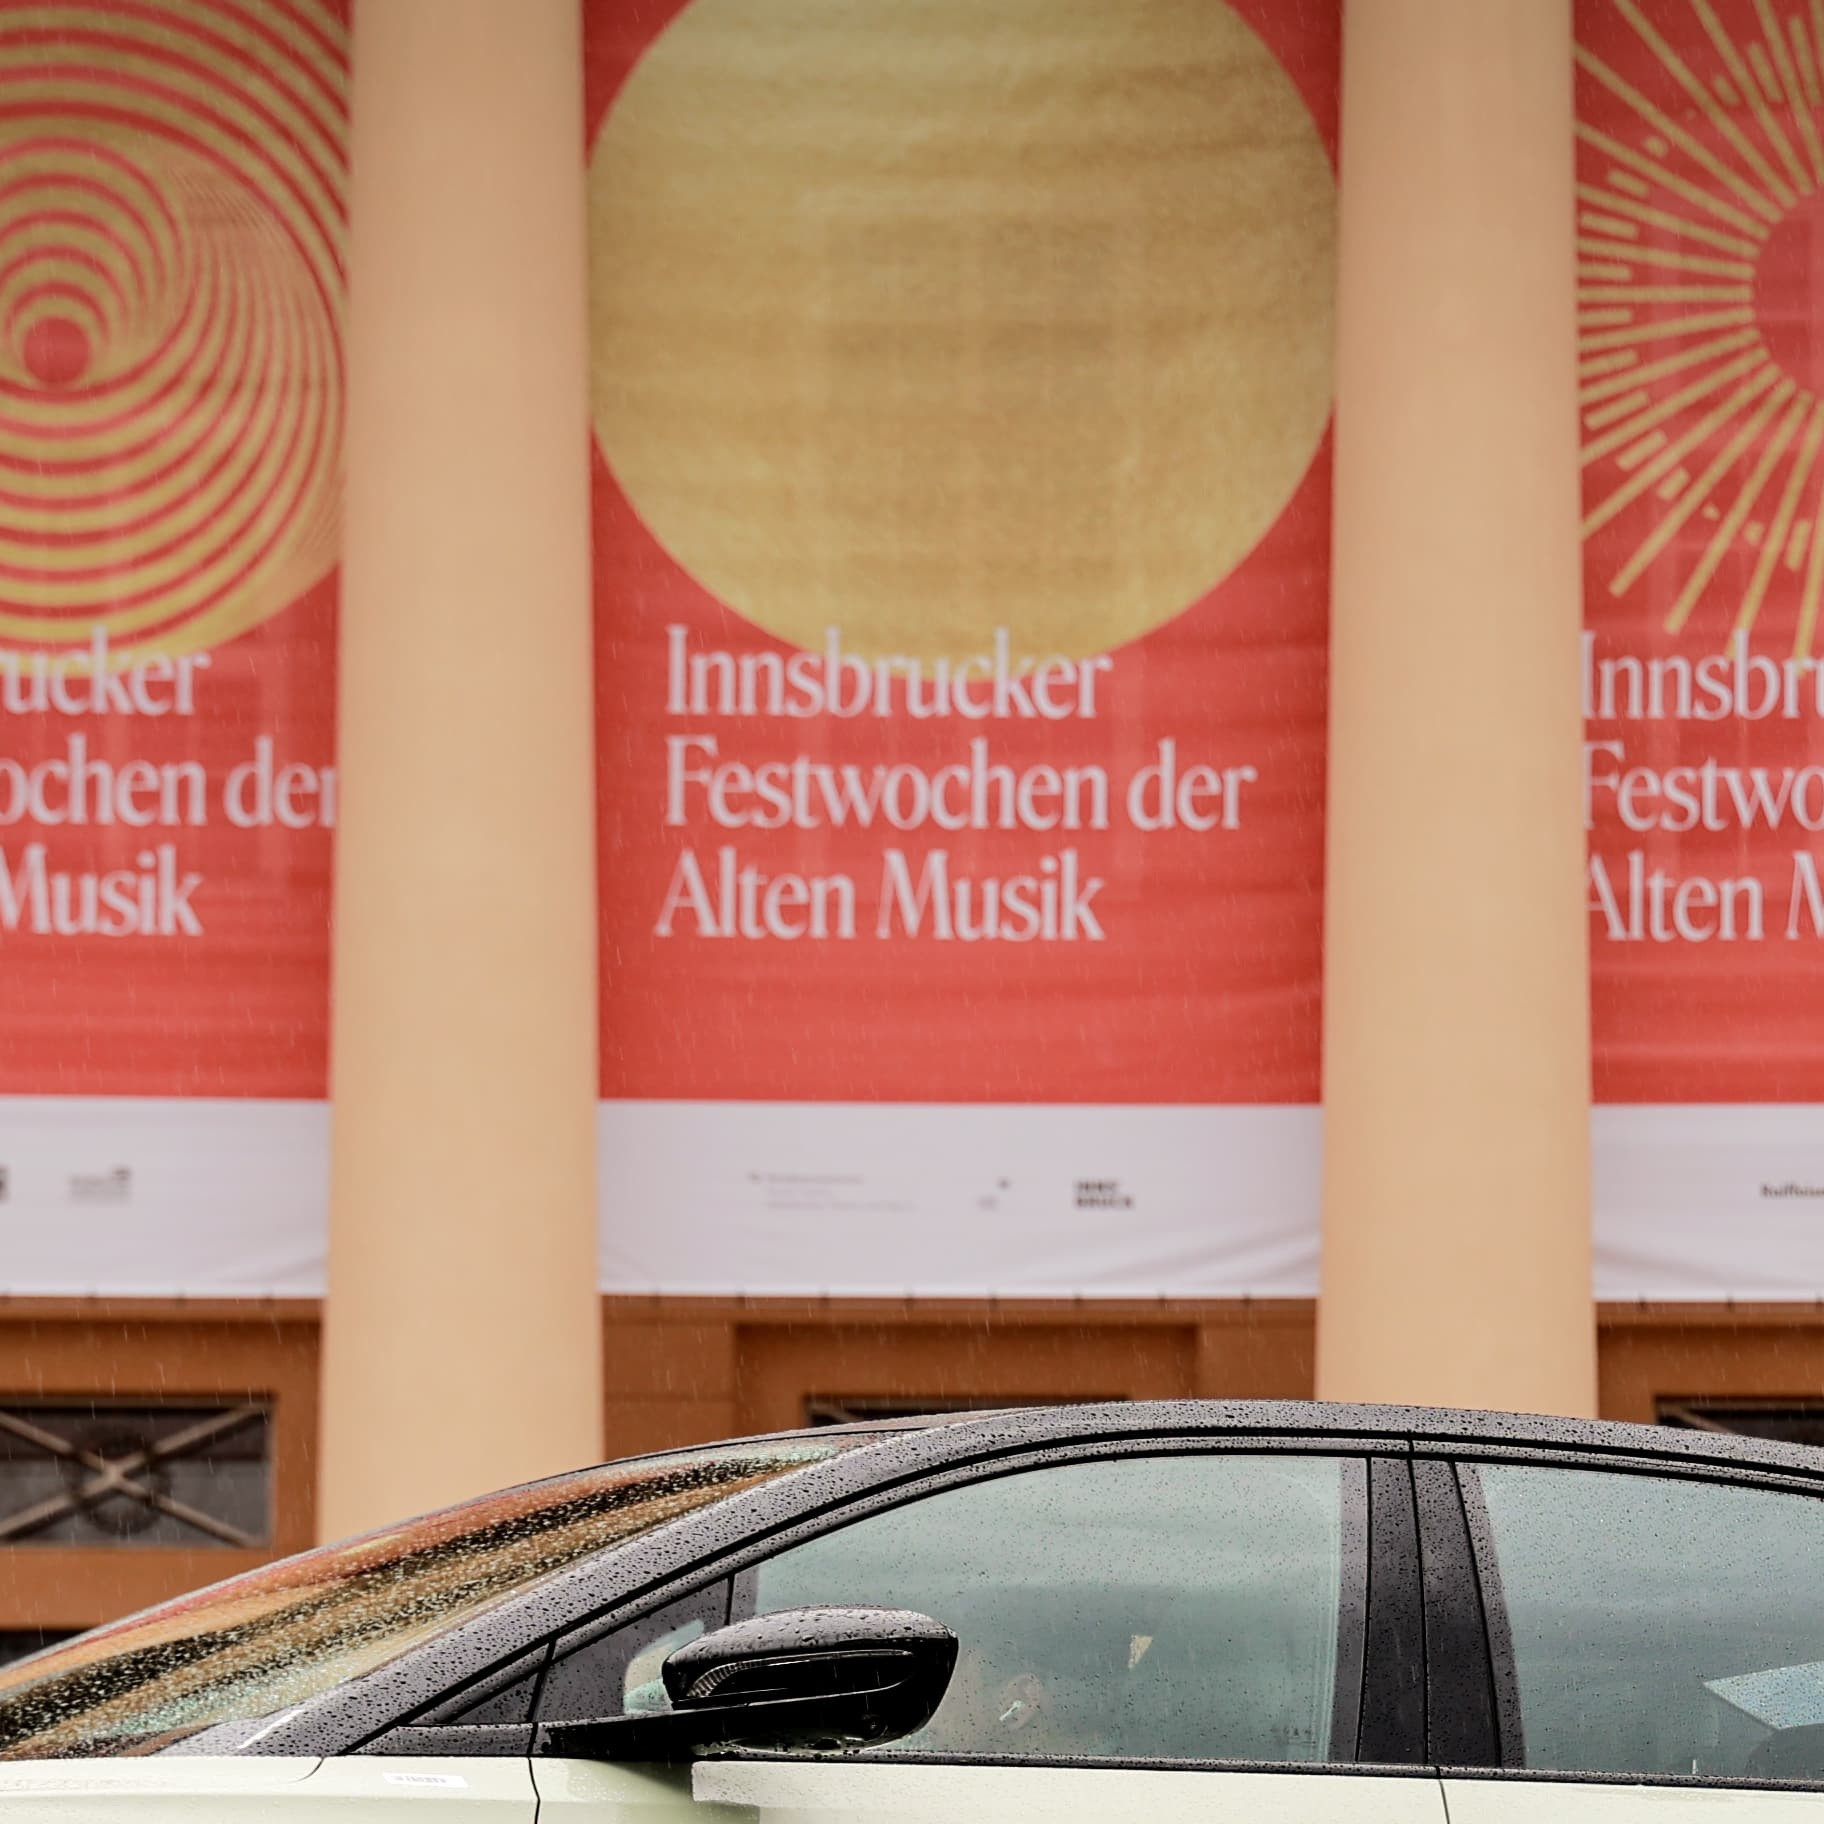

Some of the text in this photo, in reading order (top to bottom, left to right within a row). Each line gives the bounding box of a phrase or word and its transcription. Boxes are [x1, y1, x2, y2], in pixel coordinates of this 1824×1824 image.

[665, 624, 1113, 720] Innsbrucker
[665, 735, 1257, 831] Festwochen der
[654, 846, 1105, 941] Alten Musik
[1587, 849, 1764, 943] Alten
